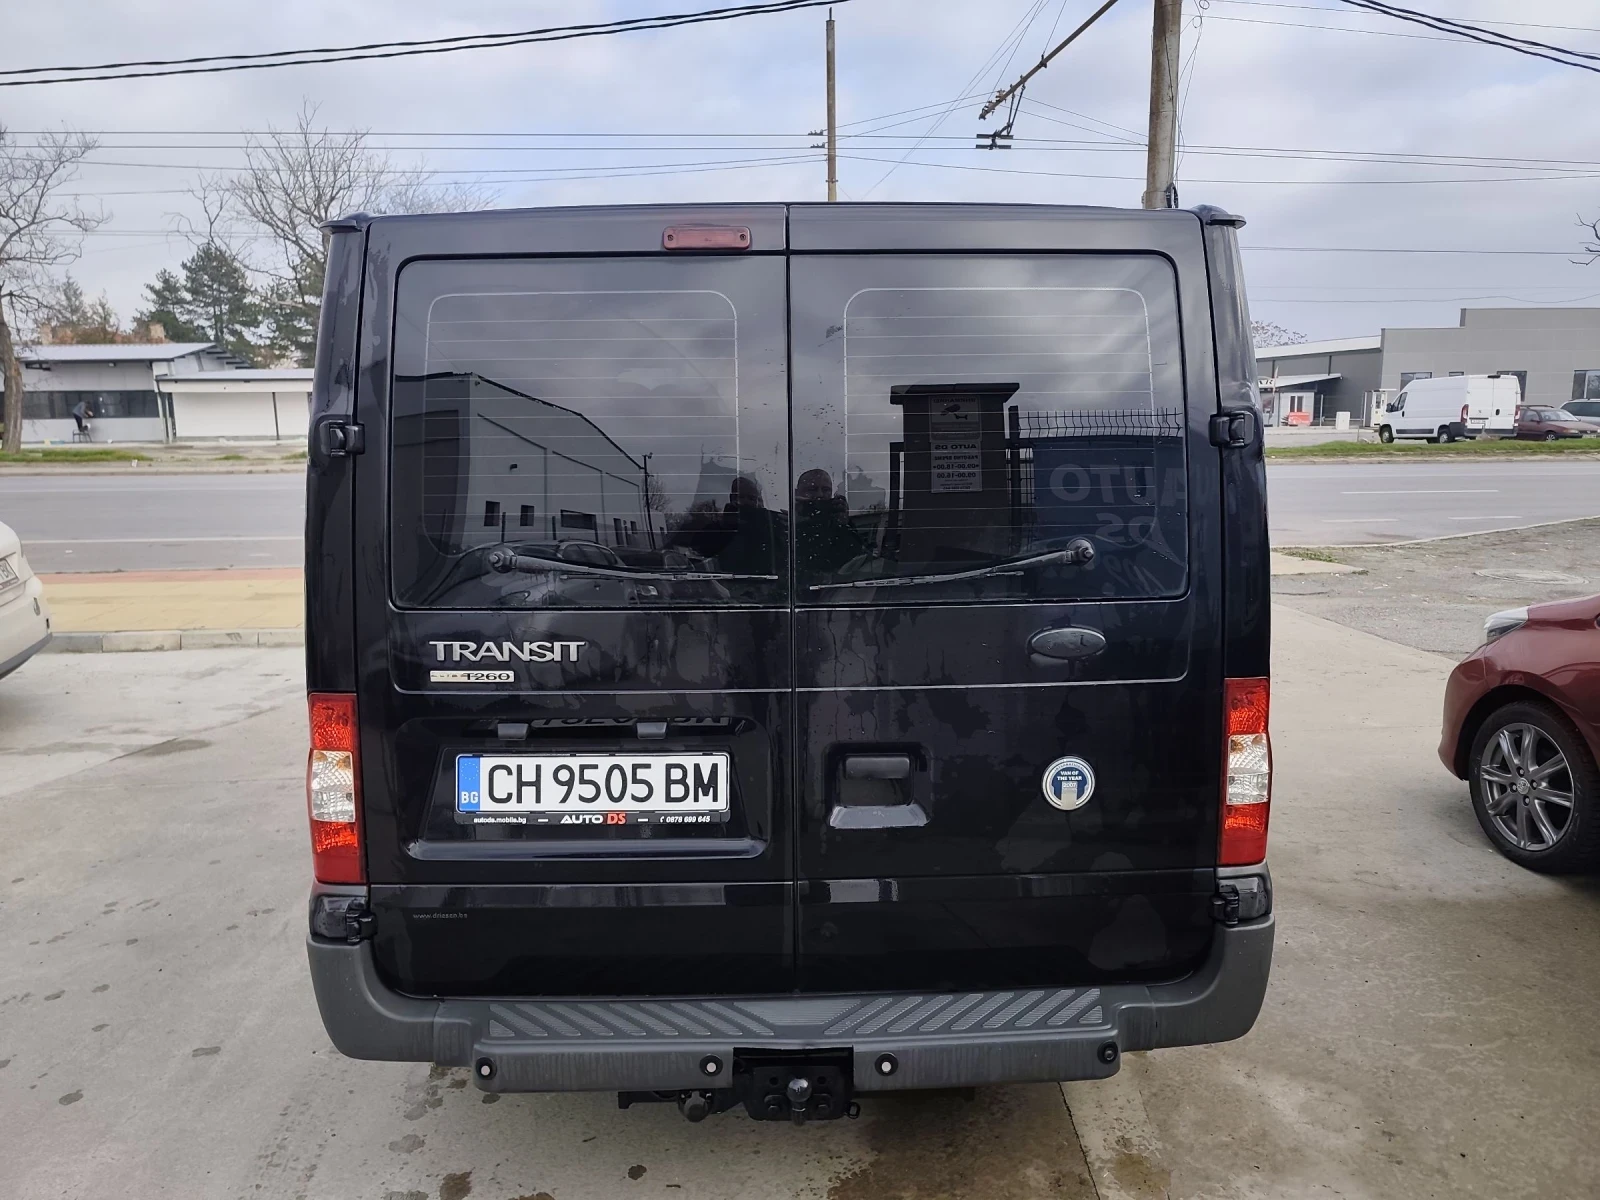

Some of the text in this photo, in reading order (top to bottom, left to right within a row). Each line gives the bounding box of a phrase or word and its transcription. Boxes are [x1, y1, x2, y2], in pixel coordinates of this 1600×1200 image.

[429, 641, 586, 662] TRANSIT
[463, 672, 511, 681] T260
[488, 763, 719, 804] CH 9505 BM
[461, 791, 479, 804] BG
[559, 813, 627, 825] AUTO DS
